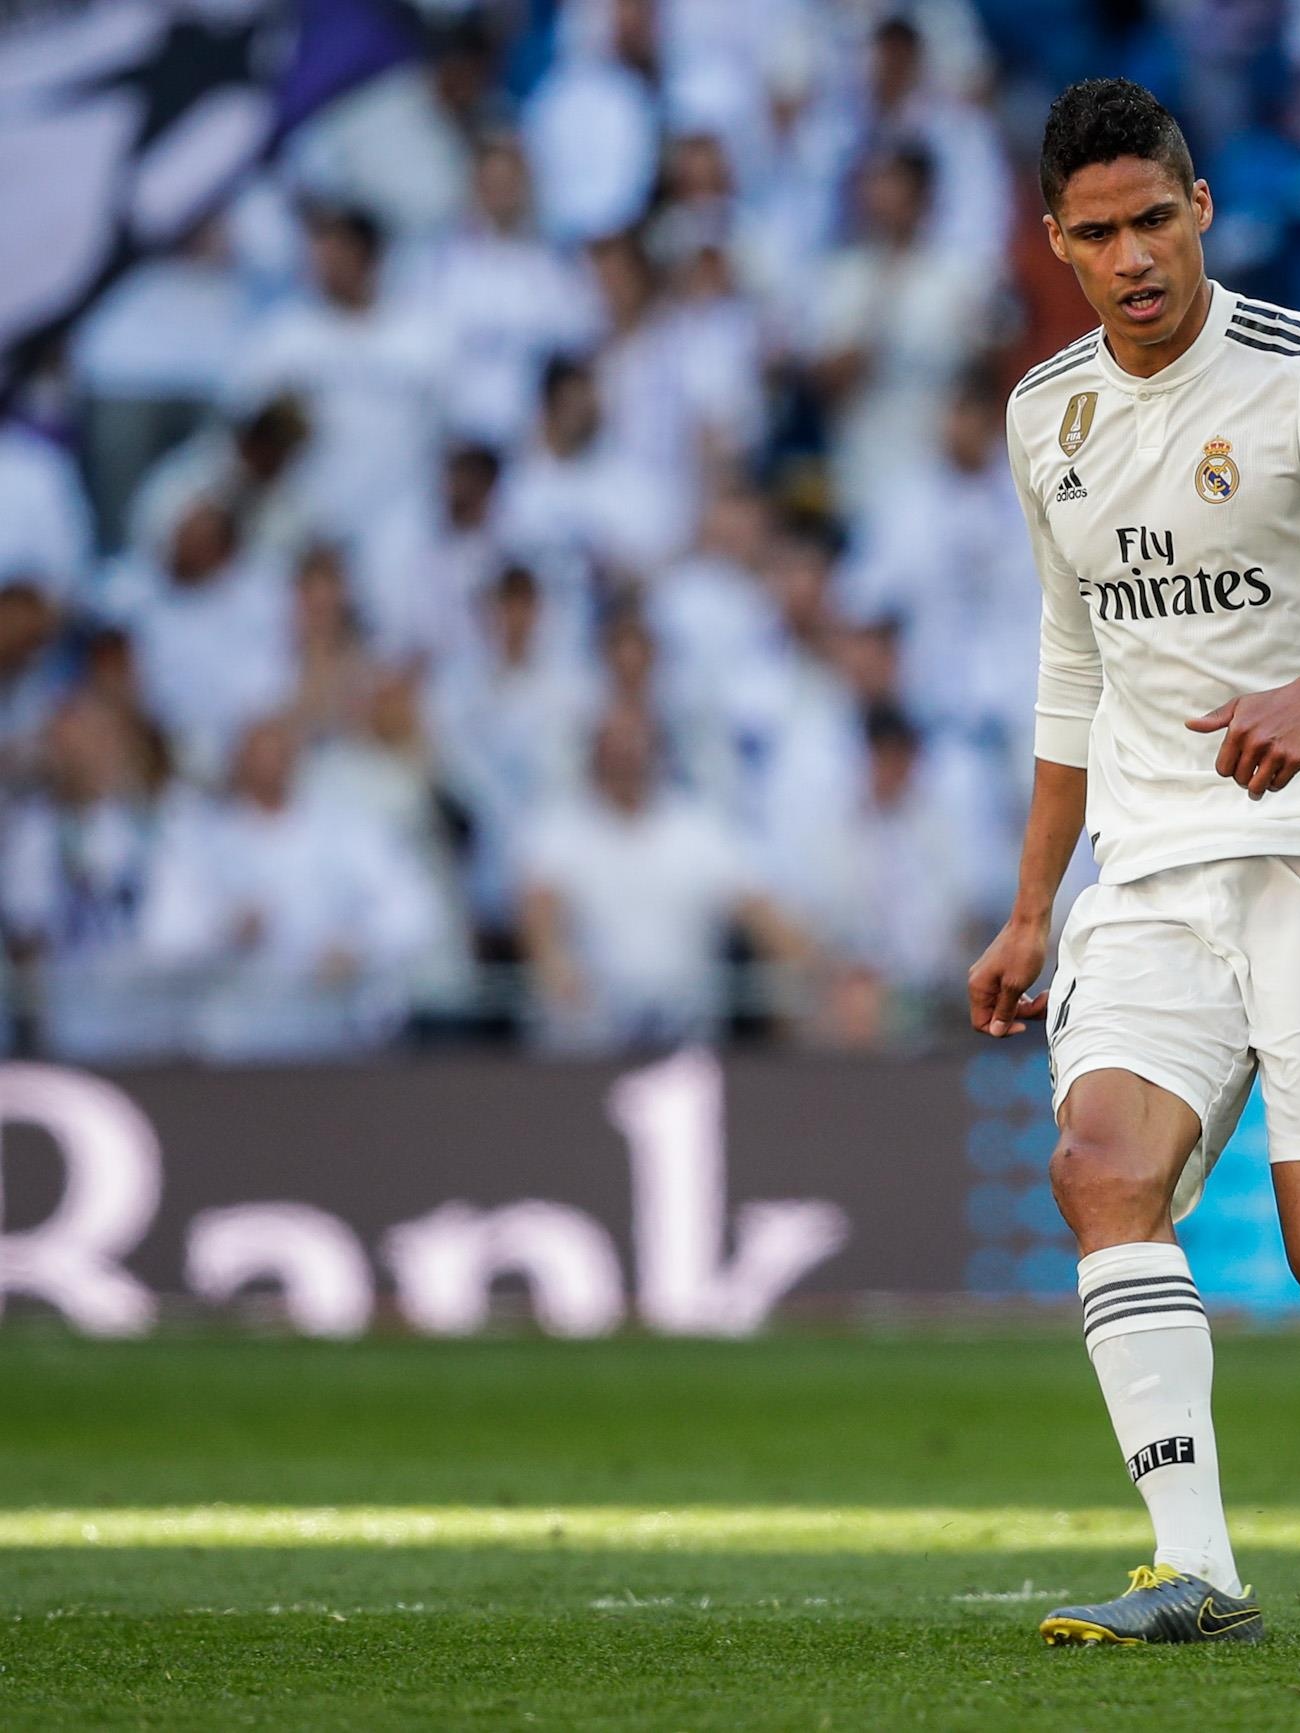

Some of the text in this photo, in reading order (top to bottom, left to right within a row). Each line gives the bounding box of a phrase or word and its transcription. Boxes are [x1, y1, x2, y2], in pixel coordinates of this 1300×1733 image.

[1066, 432, 1081, 442] FIFA
[1056, 487, 1088, 502] adidas
[1115, 526, 1174, 565] Fly
